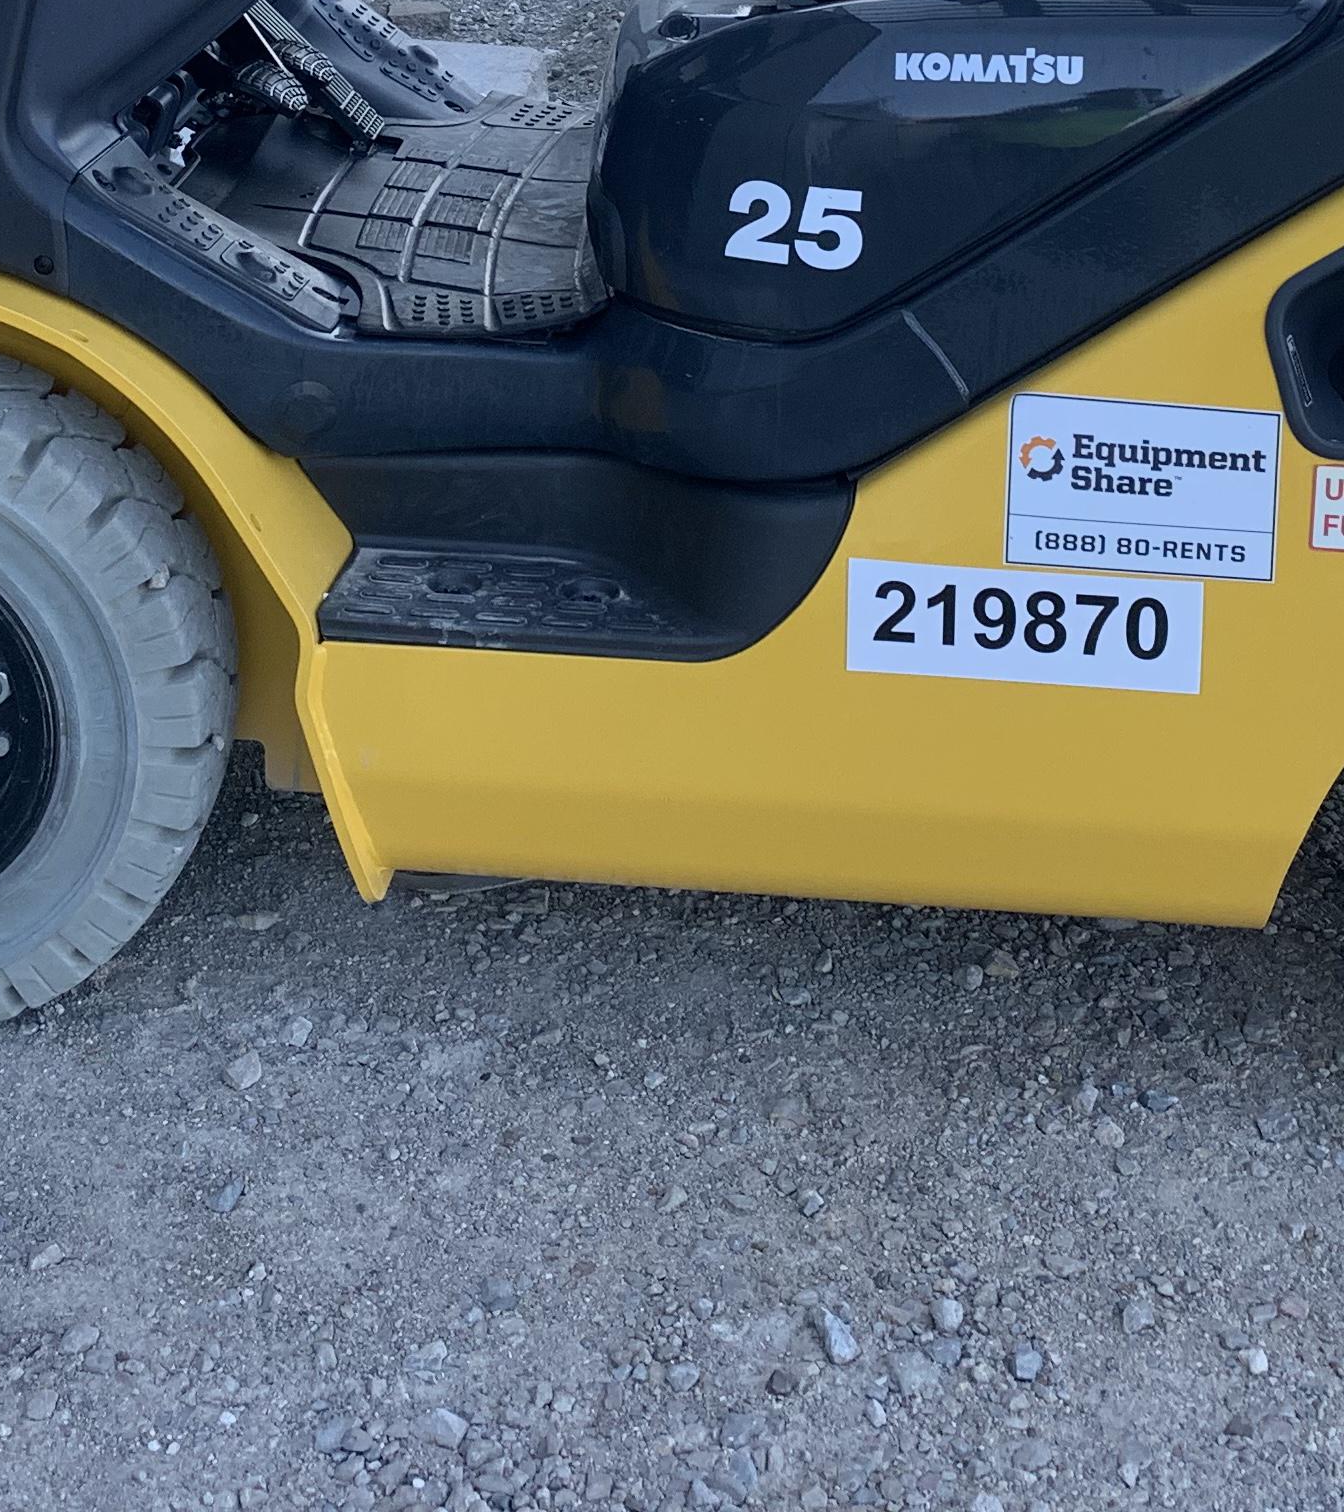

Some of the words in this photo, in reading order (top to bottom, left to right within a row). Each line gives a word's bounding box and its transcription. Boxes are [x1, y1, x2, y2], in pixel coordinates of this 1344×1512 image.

[895, 48, 1084, 85] KOMATSU
[724, 180, 863, 270] 25
[1072, 434, 1266, 472] Equipment
[1035, 530, 1106, 555] (888)
[1116, 538, 1246, 563] 80-RENTS
[873, 581, 1169, 660] 219870
